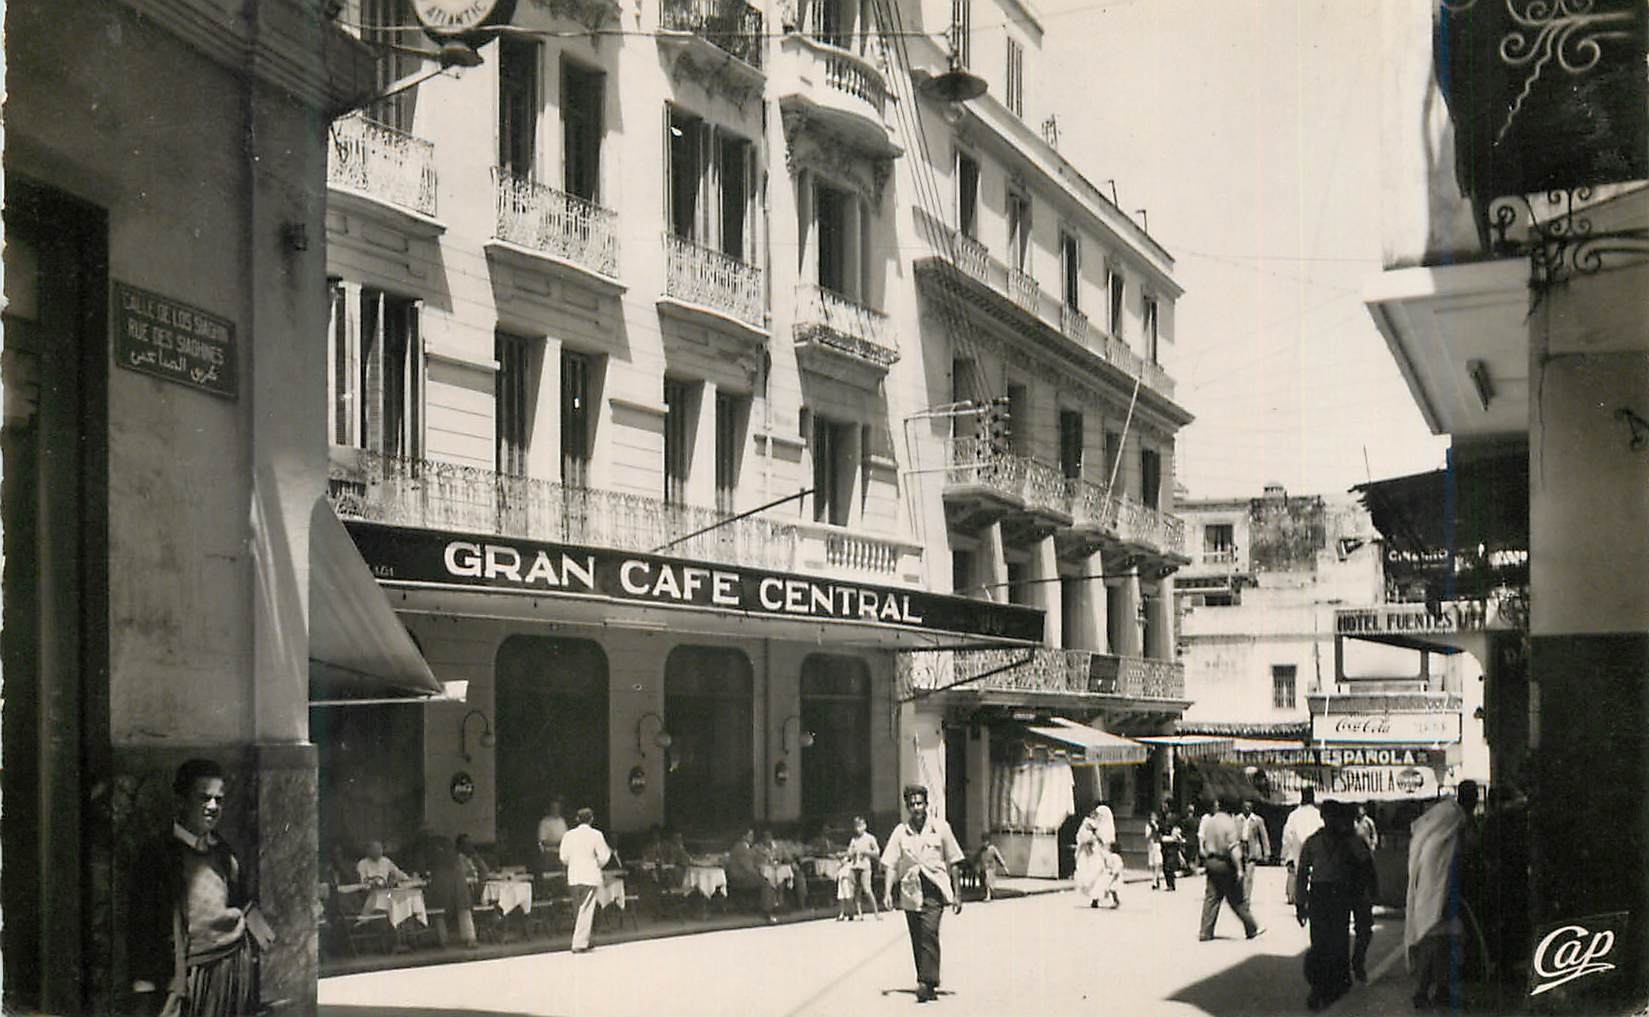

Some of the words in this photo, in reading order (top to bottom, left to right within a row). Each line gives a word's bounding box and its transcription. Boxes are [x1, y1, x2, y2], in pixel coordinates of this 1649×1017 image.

[426, 2, 486, 24] ATLANTIC
[157, 304, 171, 325] DE
[173, 308, 192, 331] LOS
[128, 318, 149, 342] RUE
[153, 326, 173, 350] DES
[443, 541, 595, 590] GRAN
[620, 559, 740, 606] CAFE
[759, 577, 923, 624] CENTRAL
[1338, 613, 1379, 632] HOTEL
